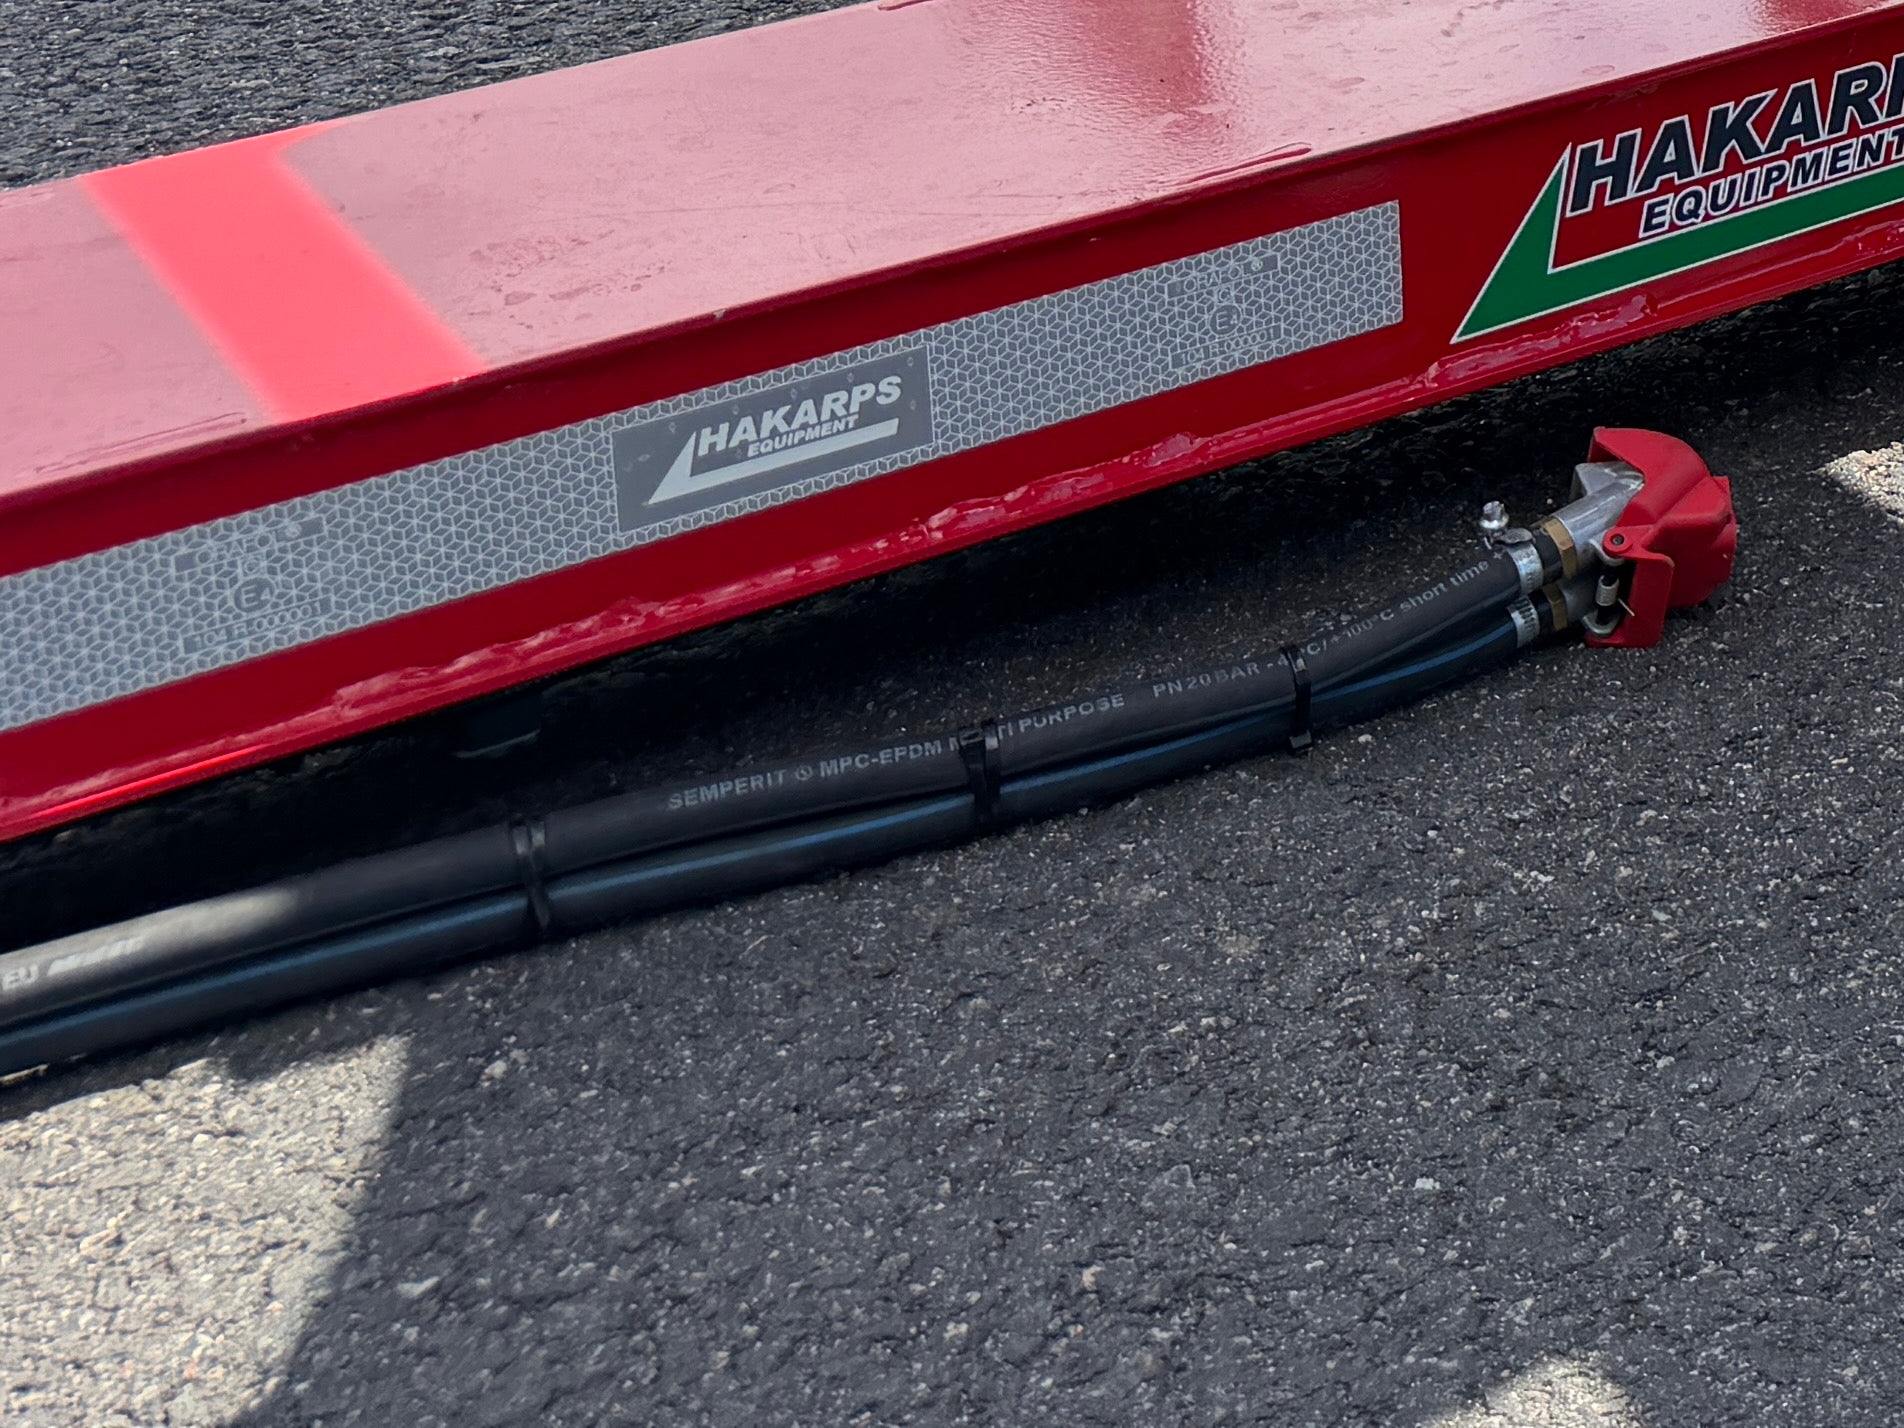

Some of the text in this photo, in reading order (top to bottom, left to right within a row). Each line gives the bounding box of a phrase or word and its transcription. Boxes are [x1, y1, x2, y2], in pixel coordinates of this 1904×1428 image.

[697, 375, 902, 456] HAKARPS
[747, 414, 859, 458] EQUIPMENT
[666, 768, 787, 812] SEMPERIT
[819, 740, 942, 779] MPC-EPDM
[1020, 693, 1125, 732] PURPOSE
[1399, 580, 1449, 613] short
[1449, 559, 1490, 591] time
